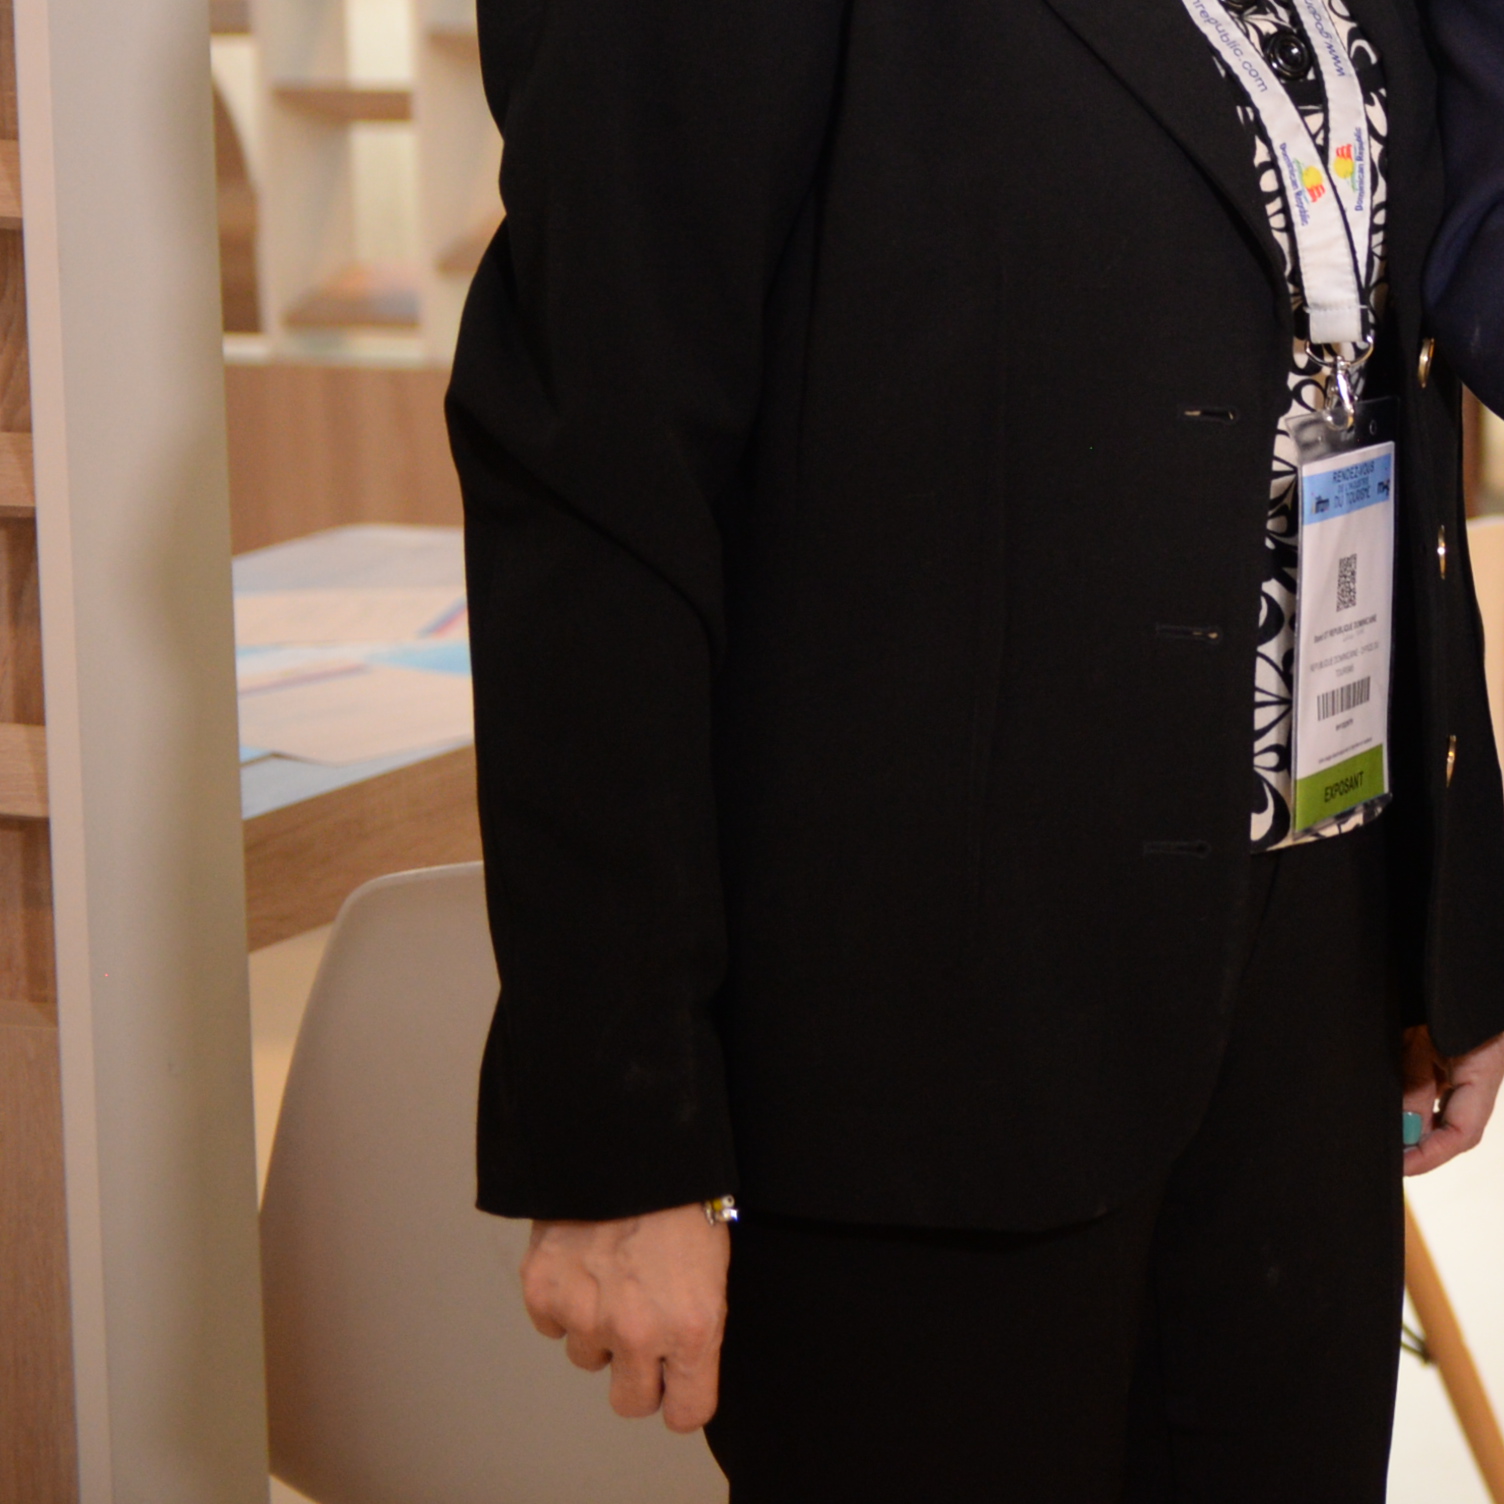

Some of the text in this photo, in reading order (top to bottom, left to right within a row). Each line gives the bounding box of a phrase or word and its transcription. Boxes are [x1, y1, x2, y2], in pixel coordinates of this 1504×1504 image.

[1280, 142, 1299, 190] Dominican
[1354, 163, 1365, 212] Dominican
[1324, 771, 1365, 804] EXPOSANT
